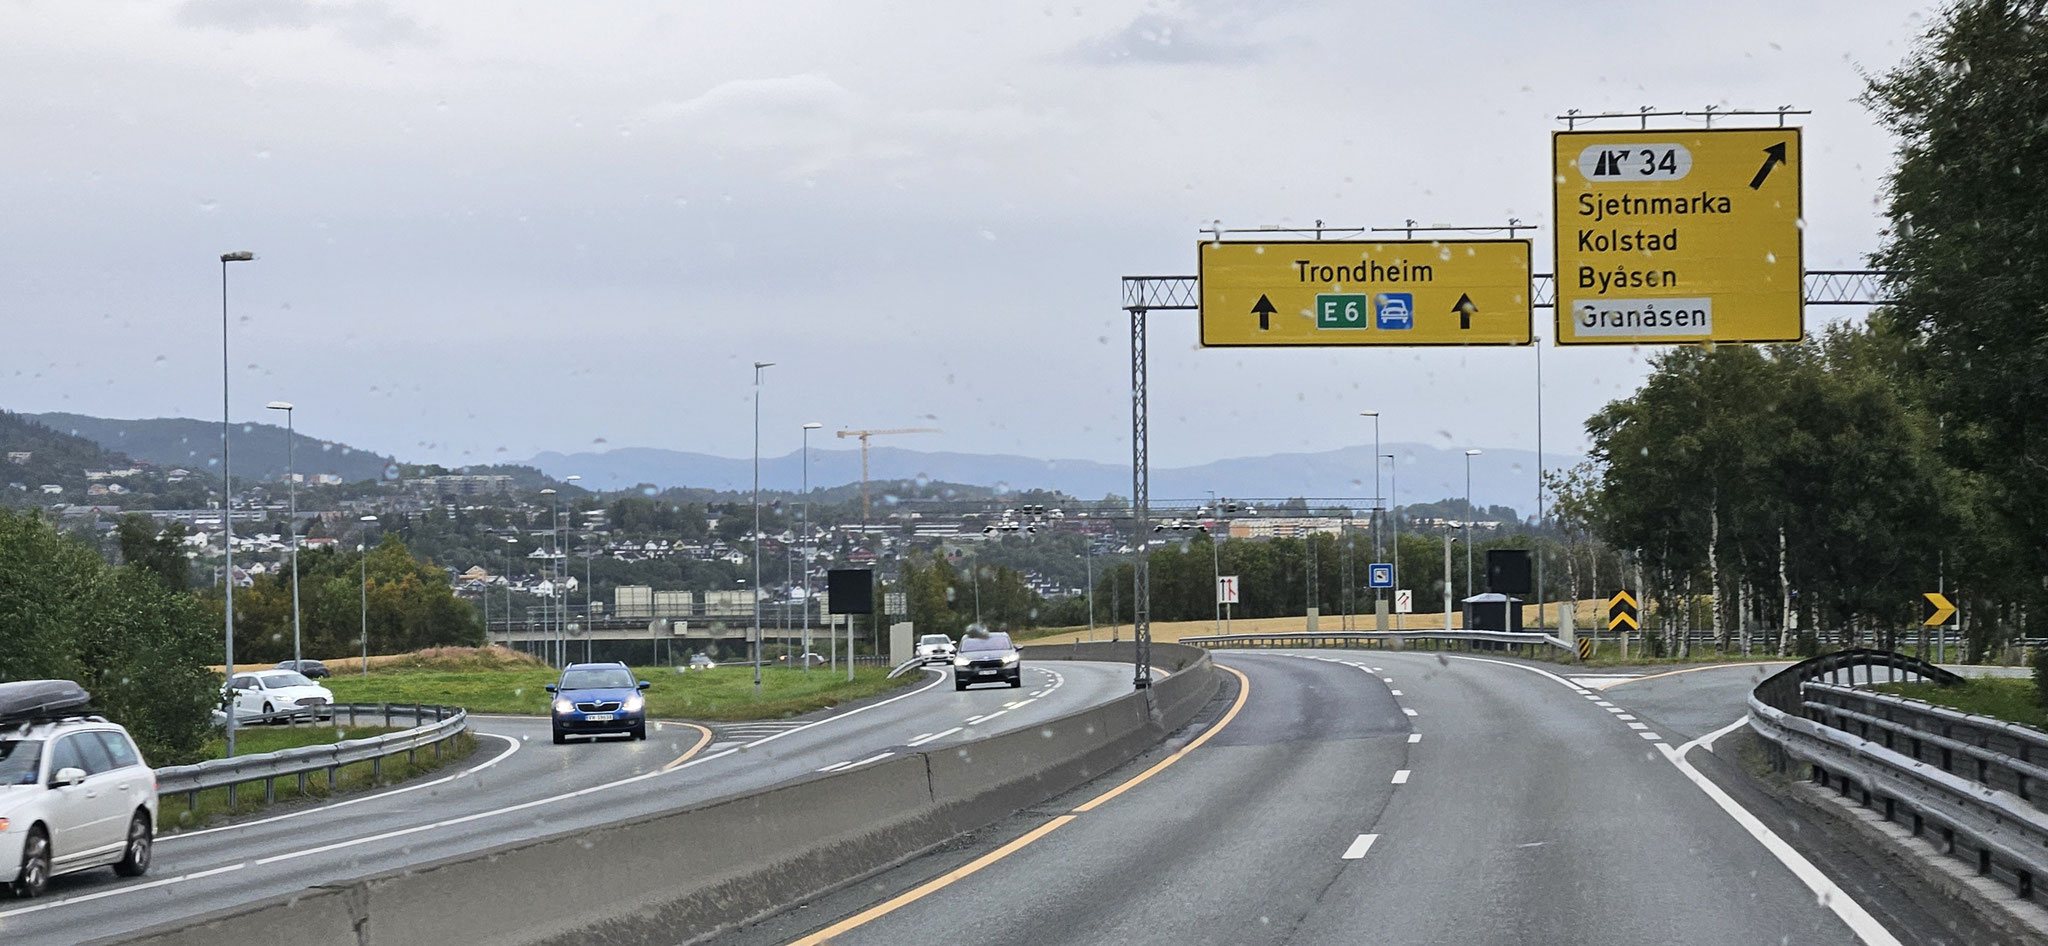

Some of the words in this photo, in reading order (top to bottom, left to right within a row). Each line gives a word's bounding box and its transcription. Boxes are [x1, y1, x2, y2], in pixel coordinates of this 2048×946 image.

[1639, 149, 1677, 175] 34
[1578, 191, 1731, 221] Sjetnmarka
[1578, 228, 1677, 251] Kolstad
[1295, 259, 1432, 282] Trondheim
[1579, 265, 1676, 294] Byåsen
[1324, 302, 1337, 321] E
[1345, 302, 1359, 321] 6
[1581, 304, 1706, 327] Granåsen
